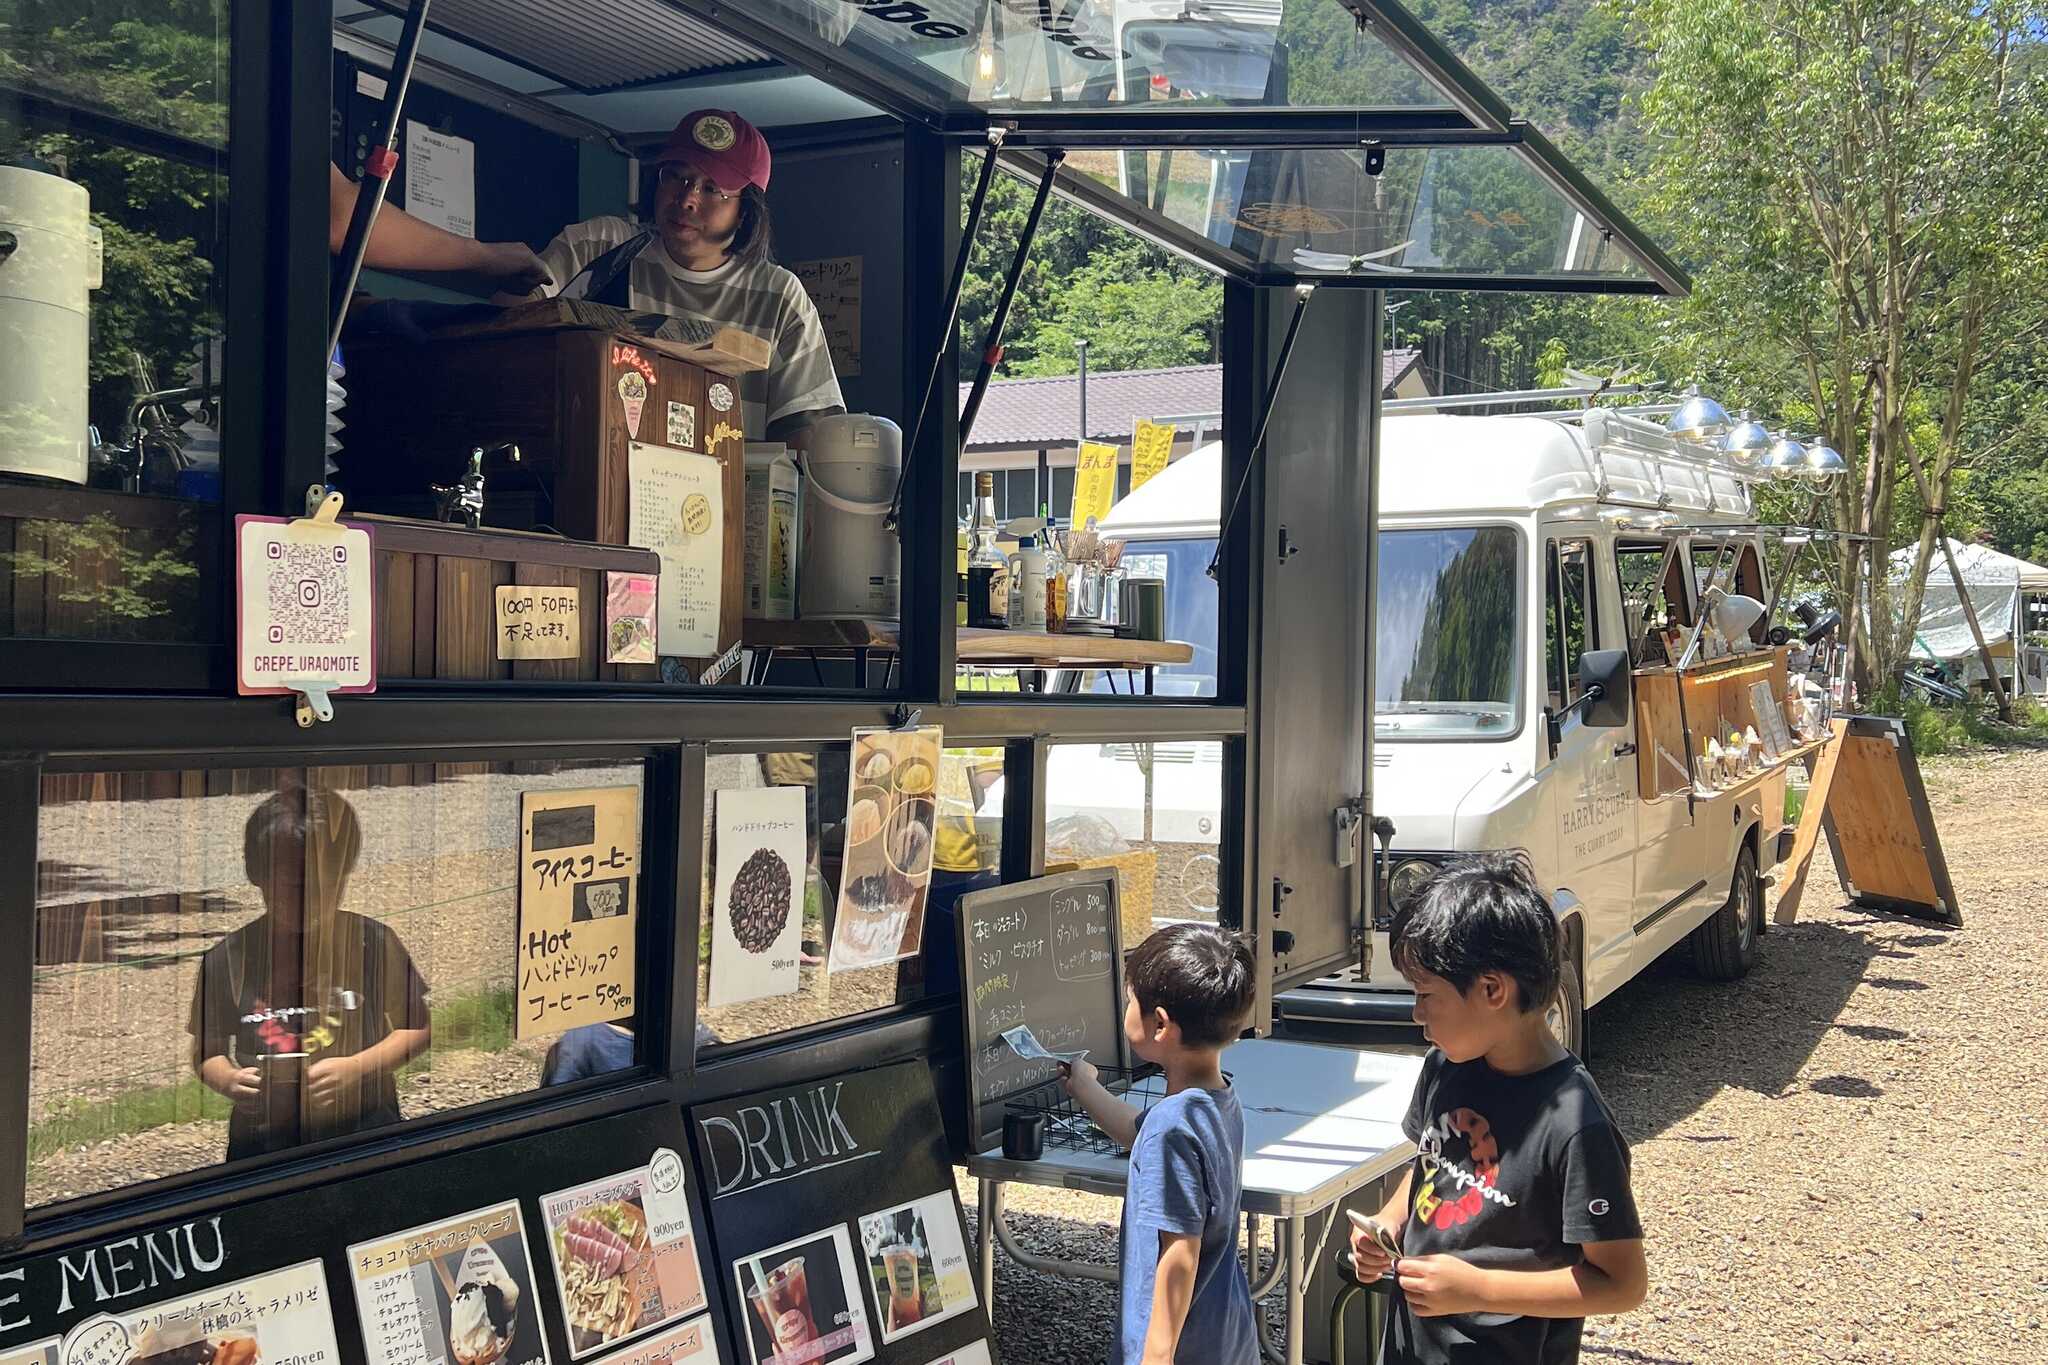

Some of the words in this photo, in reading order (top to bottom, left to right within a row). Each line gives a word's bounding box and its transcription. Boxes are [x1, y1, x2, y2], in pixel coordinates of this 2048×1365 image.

[505, 622, 570, 642] 不足してます。
[254, 656, 360, 672] CREPE_URAOMOTE
[1562, 803, 1595, 835] HARRY
[532, 846, 633, 890] アイスコーヒー
[529, 929, 572, 959] Hot
[522, 946, 619, 991] ハンドドリップ
[528, 991, 590, 1022] コーヒー
[699, 1081, 858, 1195] DRINK
[653, 1219, 685, 1238] 900yen
[57, 1216, 223, 1315] MENU
[138, 1290, 248, 1335] クリームチーズと
[202, 1286, 320, 1335] 林檎のキャラメリゼ
